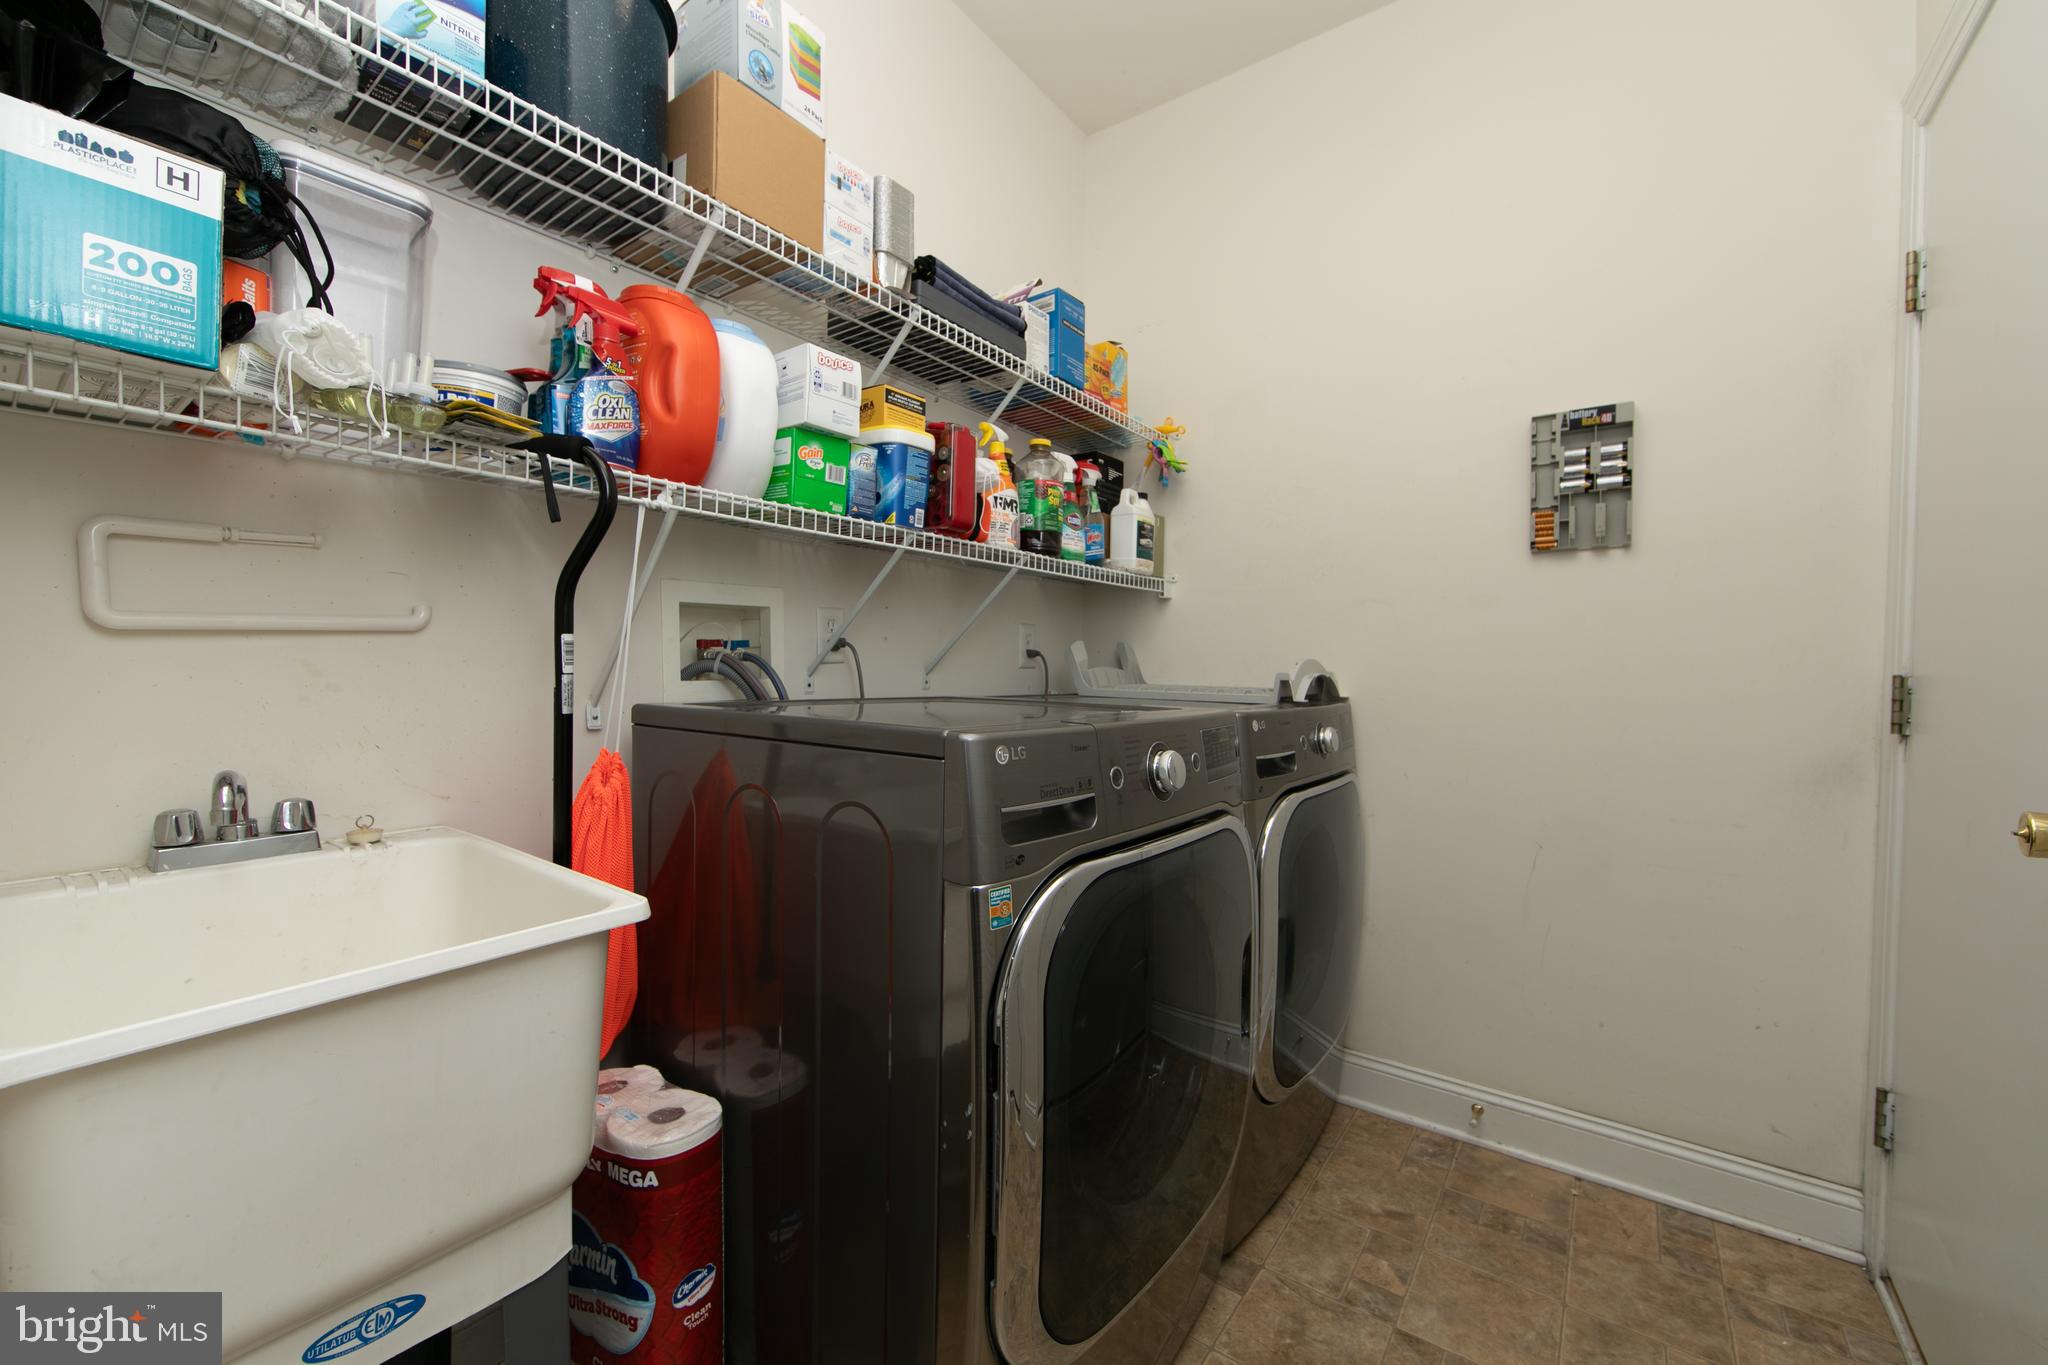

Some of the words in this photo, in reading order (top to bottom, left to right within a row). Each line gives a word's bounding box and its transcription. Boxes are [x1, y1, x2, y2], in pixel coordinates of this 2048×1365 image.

[440, 16, 481, 44] NITRILE
[811, 111, 823, 124] Pack
[53, 140, 135, 175] PLASTICPLACE
[167, 166, 190, 192] H
[88, 242, 180, 286] 200
[182, 267, 193, 293] BAGS
[107, 289, 141, 302] GALLON
[170, 305, 191, 315] LITER
[150, 313, 196, 331] Compatible
[818, 352, 854, 371] bounce
[587, 406, 632, 421] CLEAN
[597, 394, 624, 409] OXI
[1570, 408, 1597, 420] battery
[587, 422, 633, 431] MAXFORCE
[798, 446, 823, 460] Gain
[608, 1161, 659, 1188] MEGA
[568, 1292, 595, 1314] Ultra
[595, 1301, 639, 1333] Strong
[683, 1302, 712, 1326] Clean
[688, 1312, 709, 1330] Touch
[307, 1329, 357, 1359] UTILATUB
